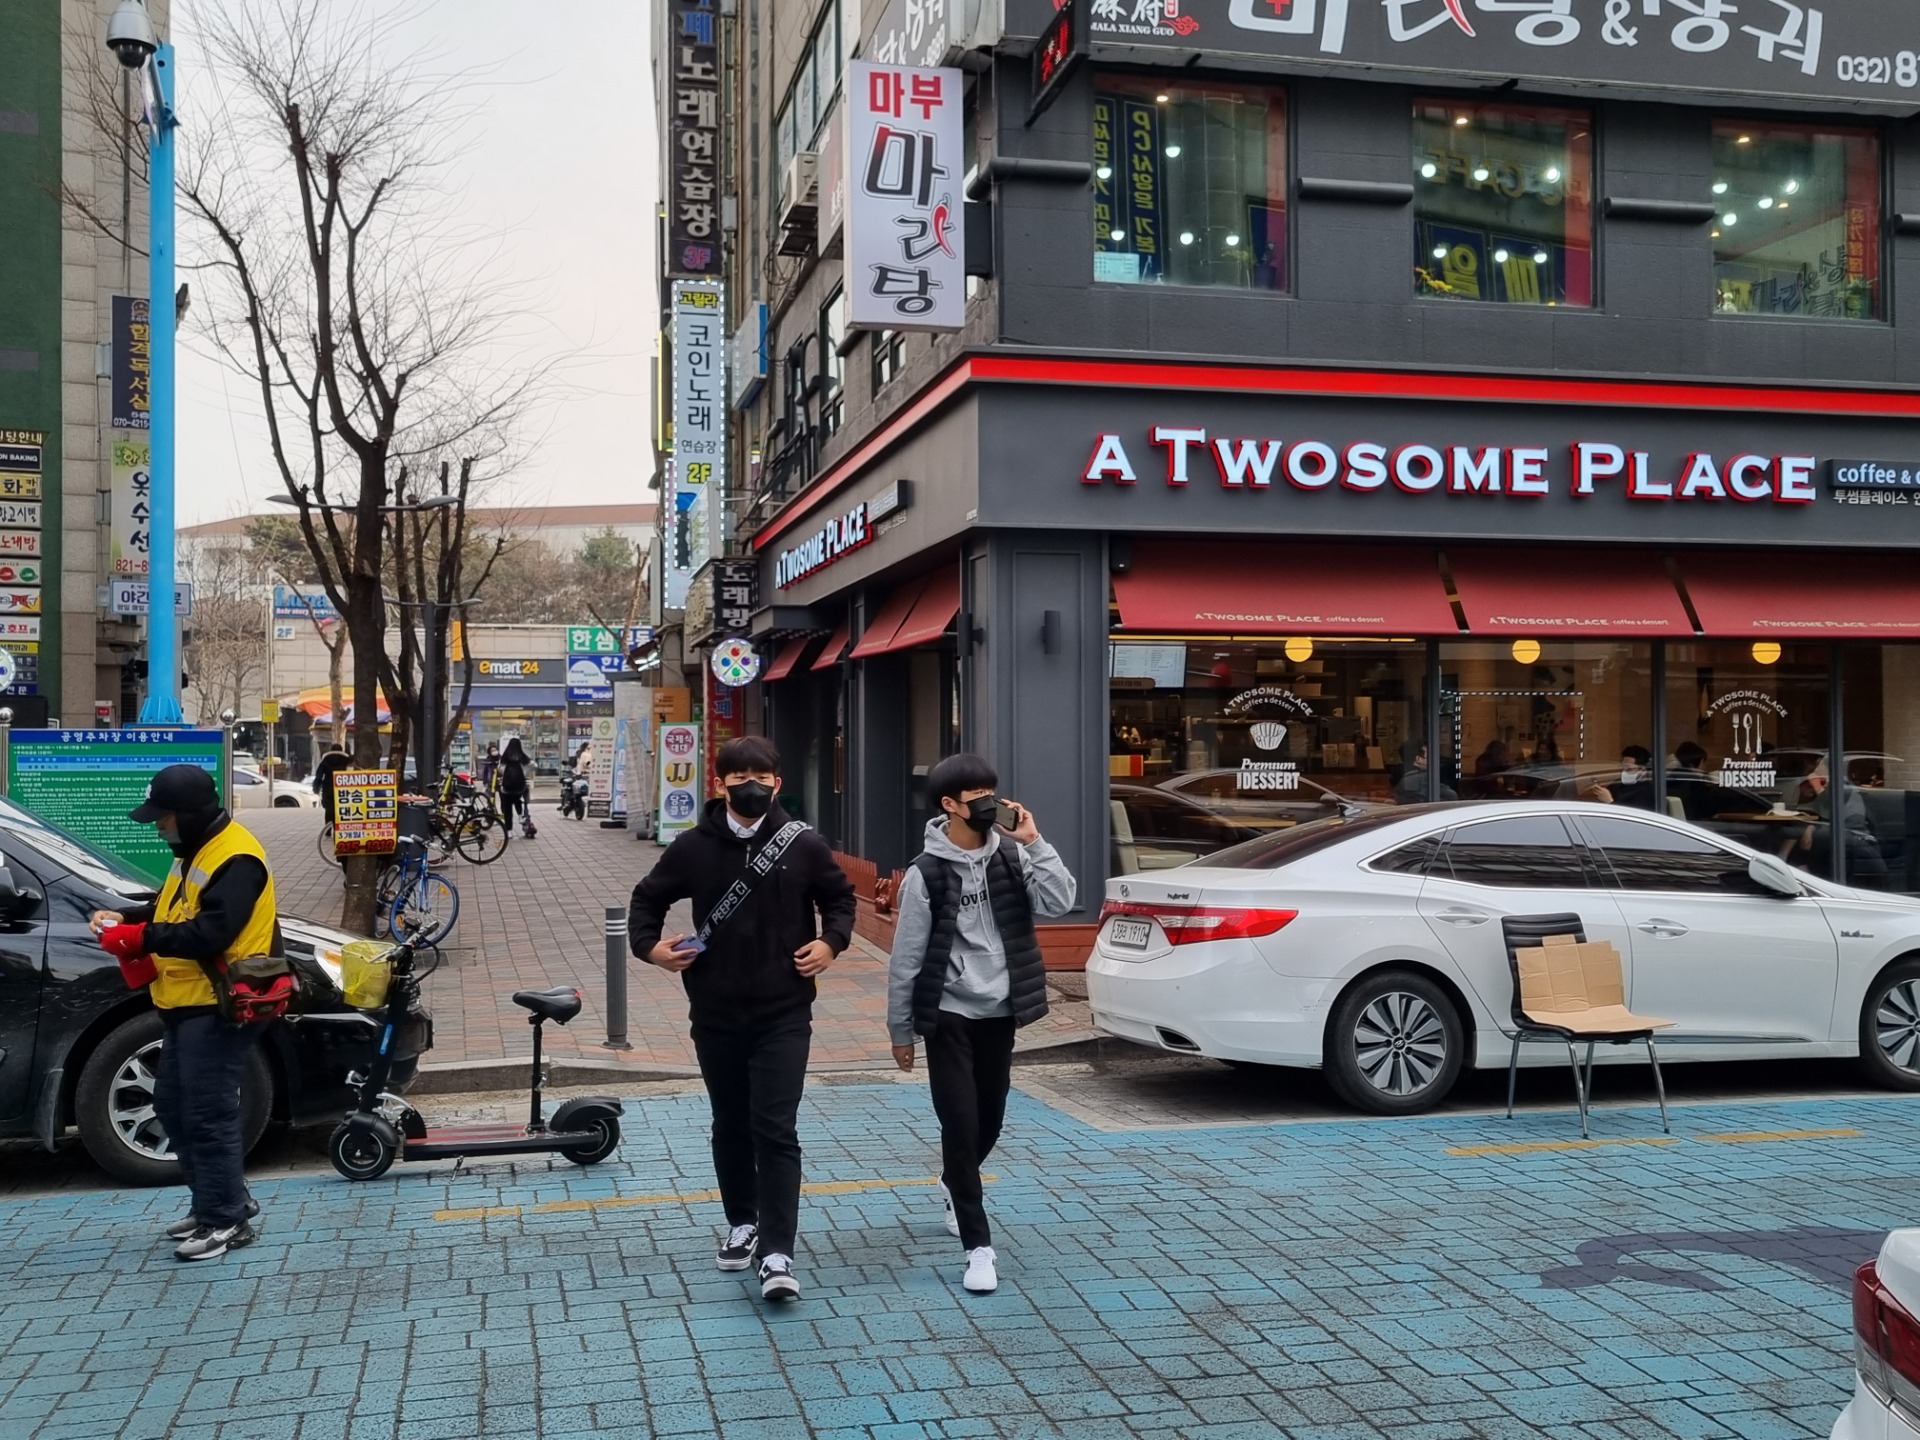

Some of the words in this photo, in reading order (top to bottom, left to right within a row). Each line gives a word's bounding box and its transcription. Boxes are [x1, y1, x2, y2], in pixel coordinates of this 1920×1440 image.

[1119, 24, 1150, 34] XIANG
[1152, 27, 1175, 36] GUO
[869, 72, 943, 120] 마부
[679, 291, 719, 309] 고릴라
[687, 325, 713, 432] 코인노래
[681, 439, 716, 454] 연습장
[1081, 433, 1137, 484] A
[1150, 426, 1549, 496] TWOSOME
[1571, 441, 1816, 503] PLACE
[687, 463, 711, 484] 2F
[1837, 463, 1896, 484] coffee
[1900, 469, 1911, 484] &
[1834, 489, 1908, 505] 투썸플레이스
[780, 530, 826, 586] TWOSOME
[826, 503, 867, 559] PLACE
[116, 559, 149, 573] 821-8
[721, 566, 750, 628] 노래방
[277, 628, 293, 638] 2F
[479, 661, 539, 674] emart24
[1228, 687, 1282, 708] TWOSOME
[1283, 690, 1313, 717] PLACE
[1241, 698, 1262, 712] coffee
[1269, 697, 1295, 713] dessert
[1711, 690, 1759, 710] TWOSOME
[1760, 693, 1788, 718] PLACE
[1722, 701, 1741, 713] coffee
[1748, 700, 1771, 714] dessert
[61, 731, 121, 742] 공영주차장
[126, 732, 173, 742] 이용안내
[1722, 757, 1773, 769] Premium
[336, 774, 368, 786] GRAND
[369, 773, 394, 784] OPEN
[666, 762, 692, 783] JJ
[1724, 770, 1776, 787] DESSERT
[1243, 772, 1300, 790] DESSERT
[338, 789, 363, 804] 방송
[670, 795, 690, 805] 당구
[338, 806, 363, 821] 댄스
